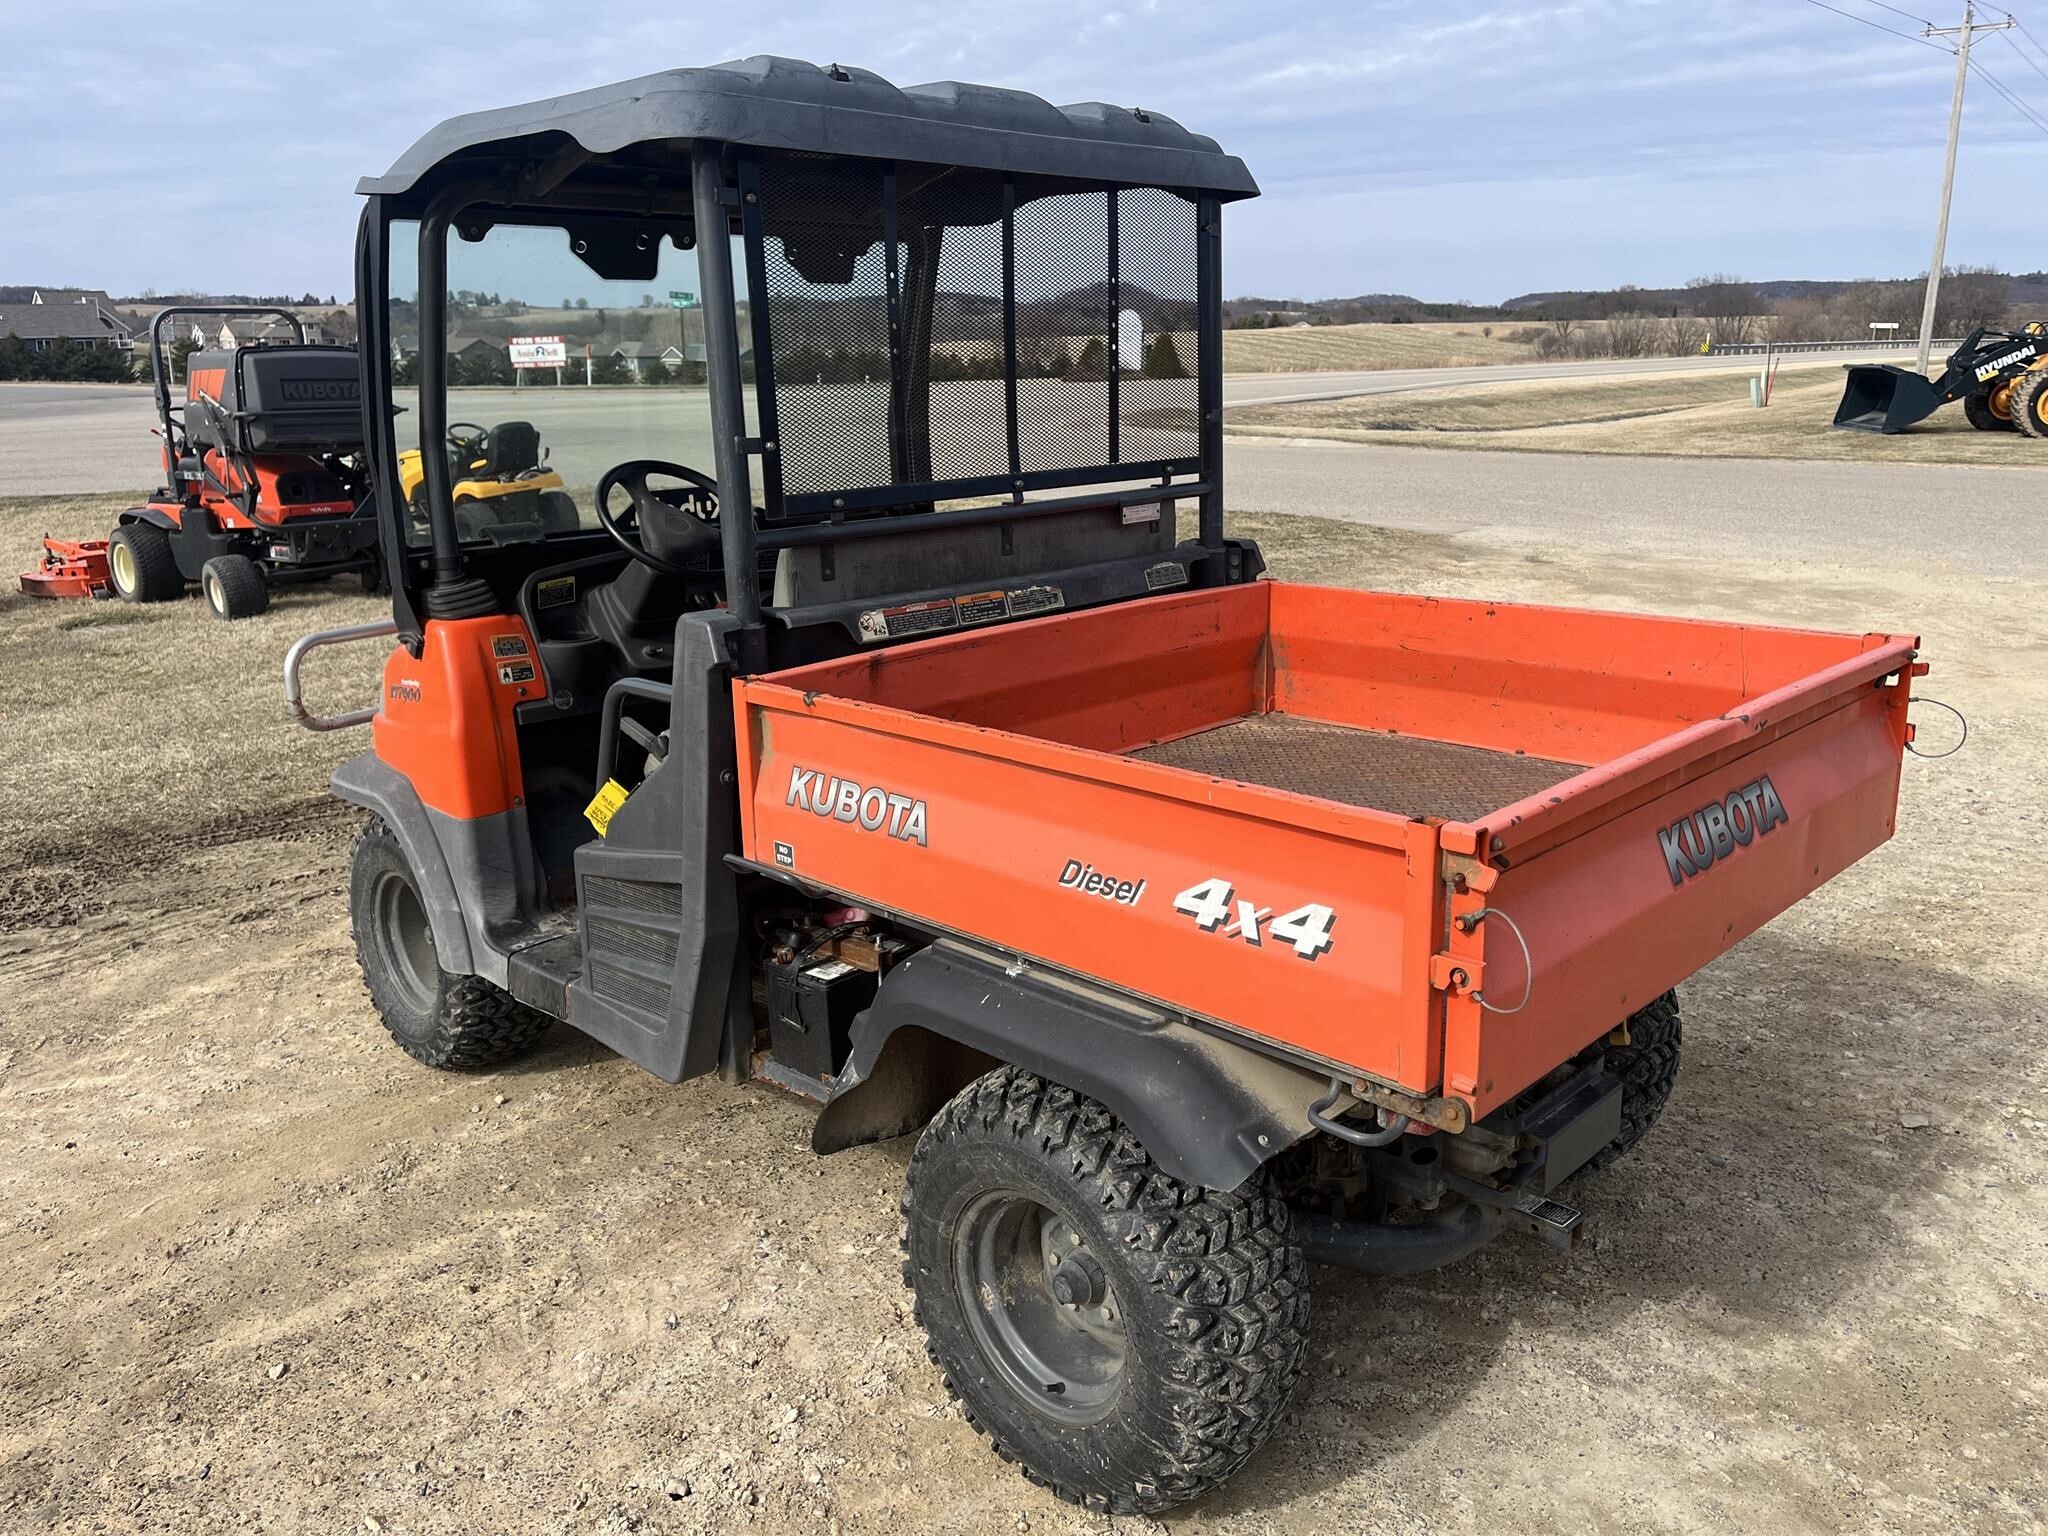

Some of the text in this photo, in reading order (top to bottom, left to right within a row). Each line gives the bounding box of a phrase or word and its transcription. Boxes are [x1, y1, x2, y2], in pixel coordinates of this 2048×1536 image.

[512, 337, 533, 345] FOR
[1974, 344, 2036, 376] HYUNDAI
[281, 382, 360, 400] KUBOTA
[786, 765, 928, 848] KUBOTA
[1658, 774, 1789, 886] KUBOTA
[776, 854, 792, 865] STEP
[778, 845, 788, 855] NO
[1058, 858, 1147, 907] Diesel
